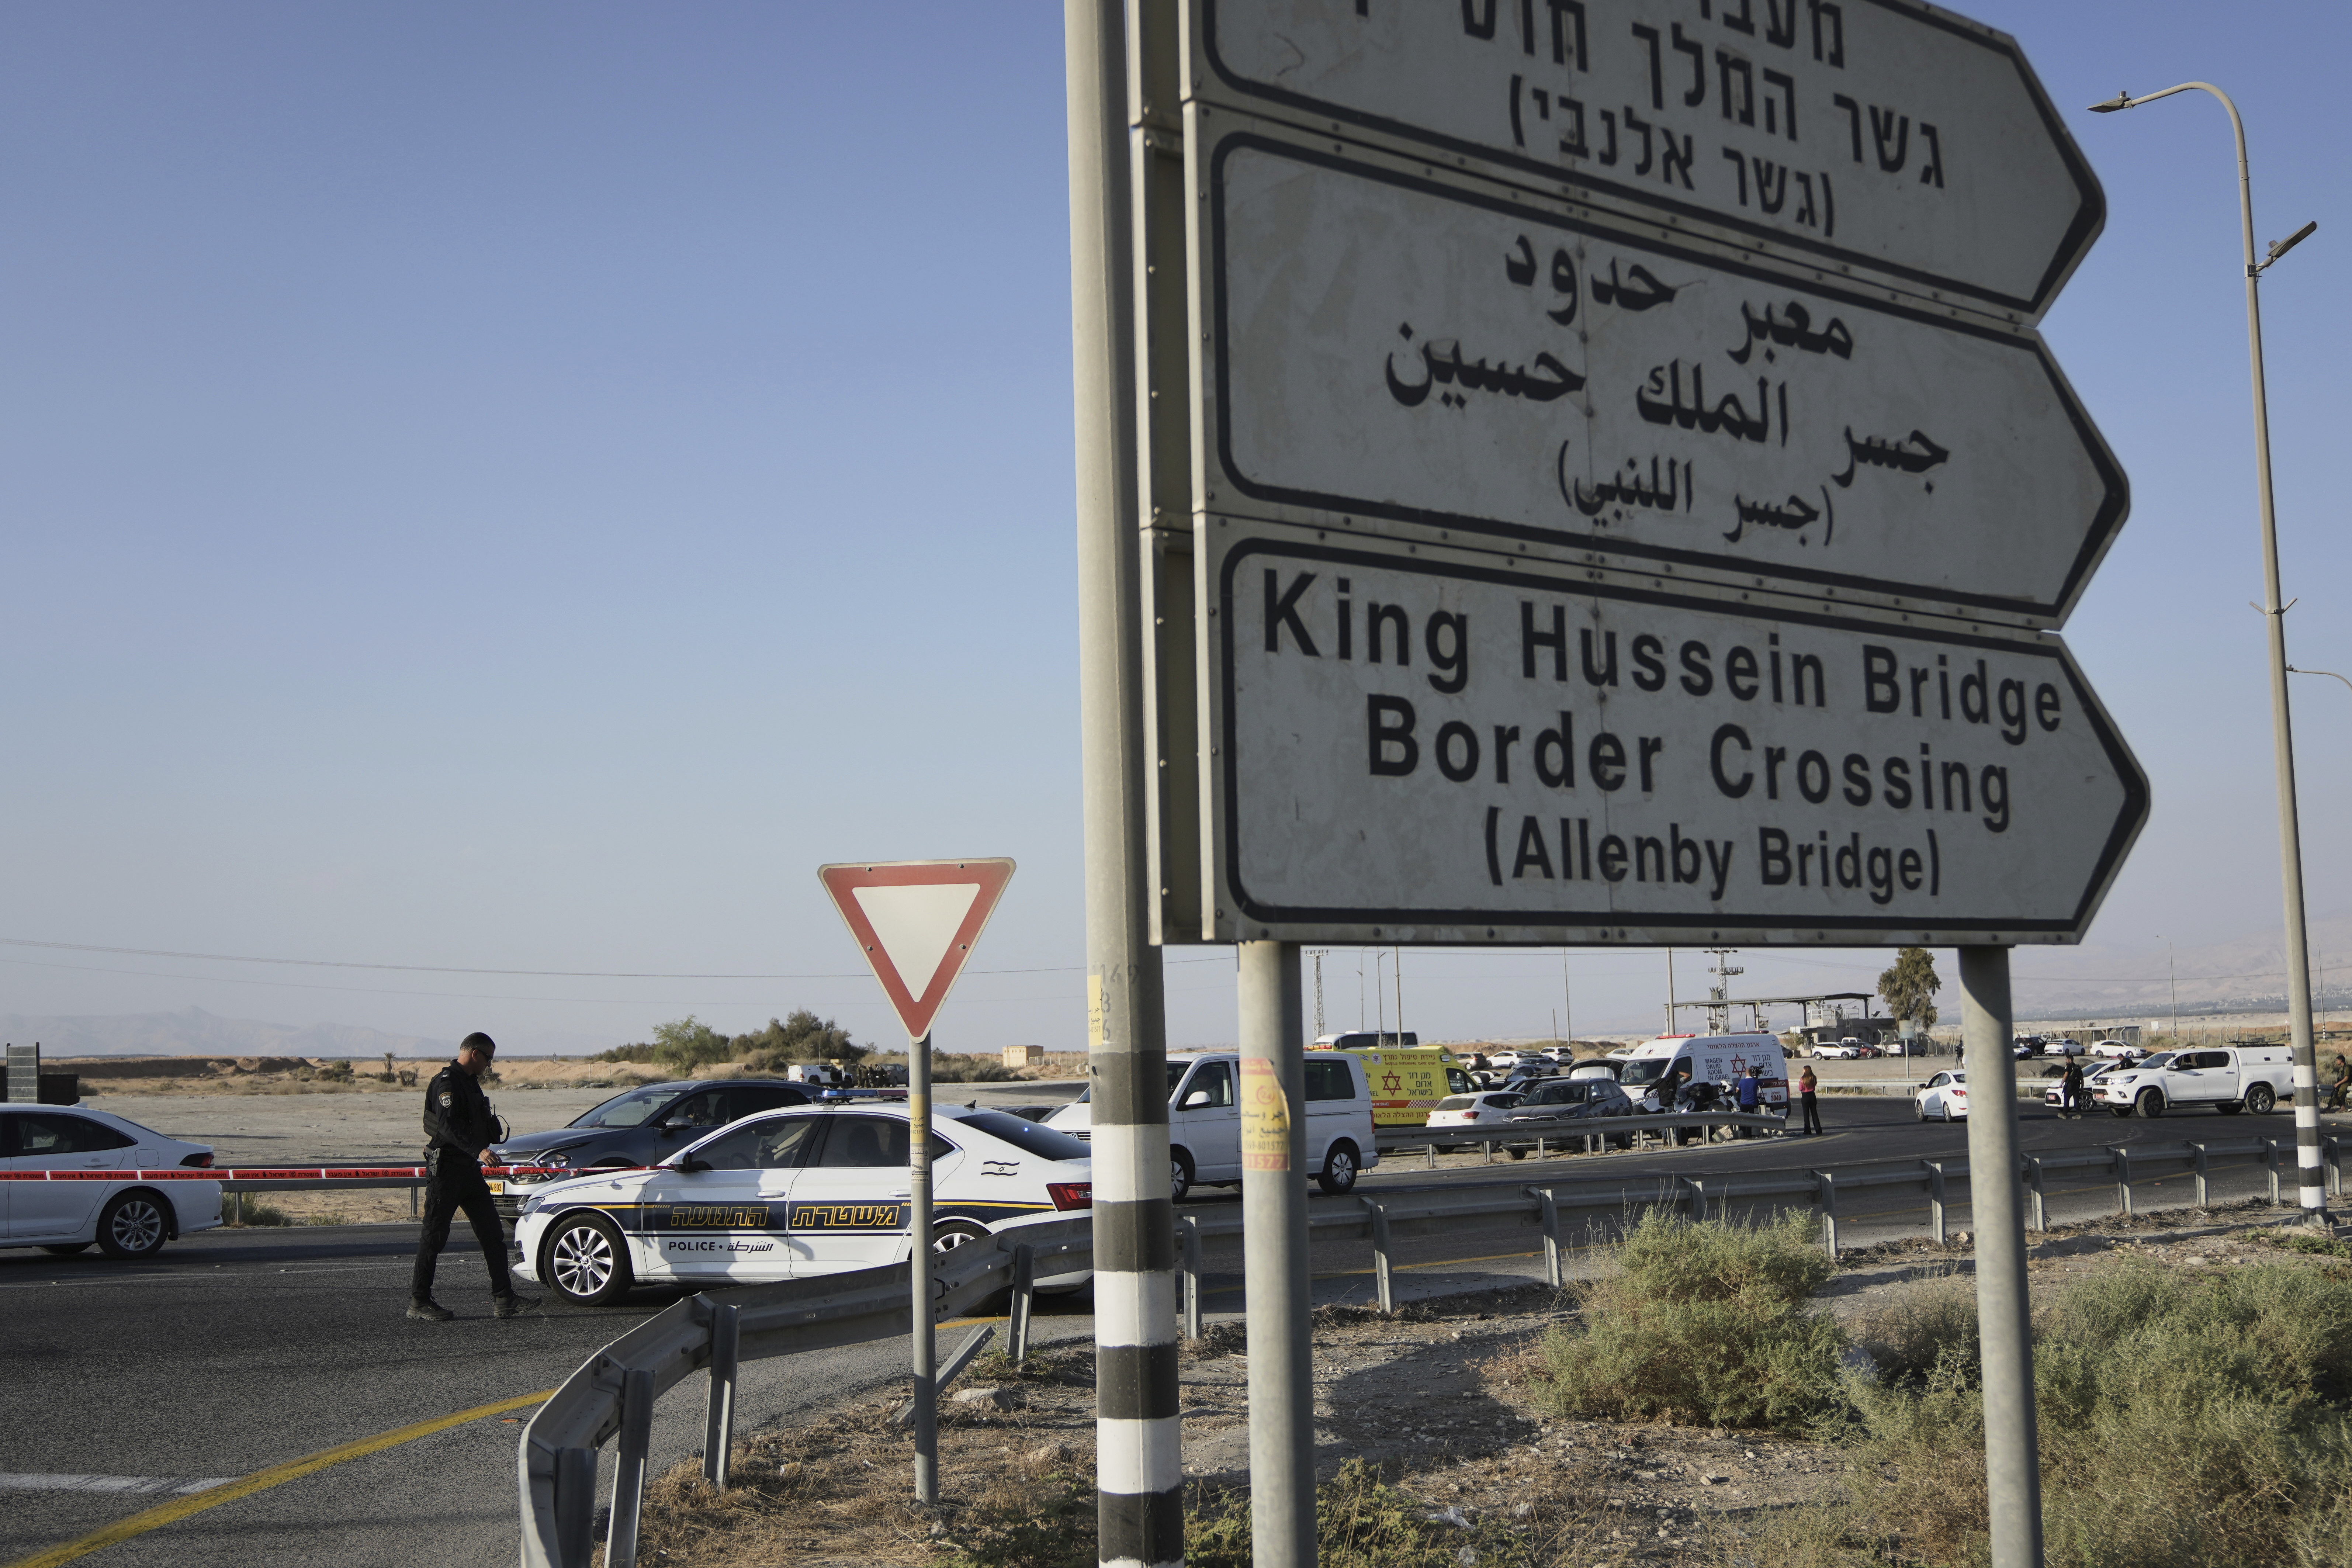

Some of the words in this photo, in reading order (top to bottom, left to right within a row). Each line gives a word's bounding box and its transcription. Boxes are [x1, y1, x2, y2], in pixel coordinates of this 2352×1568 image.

[1632, 22, 1797, 141] המלך
[1510, 75, 1694, 190] אלנבי)
[1834, 93, 1944, 188] גשר
[1723, 148, 1833, 237] (גשר
[1506, 235, 1677, 326] حدود
[1386, 323, 1586, 409] حسين
[1727, 301, 1853, 364] معبر
[1636, 359, 1788, 447] الملك
[1558, 440, 1692, 527] اللنبي)
[1832, 426, 1949, 494] جسر
[1723, 486, 1833, 547] (جسر
[1264, 569, 1468, 694] King
[1521, 601, 1825, 707] Hussein
[1863, 645, 2060, 745] Bridge
[1368, 694, 1661, 792] Border
[1711, 724, 2009, 833] Crossing
[1486, 806, 1733, 900] (Allenby
[1759, 827, 1939, 900] Bridge)
[669, 1242, 715, 1251] POLICE
[671, 1207, 769, 1226] התנועה
[727, 1241, 774, 1253] الشرطة
[792, 1206, 899, 1226] משטרת
